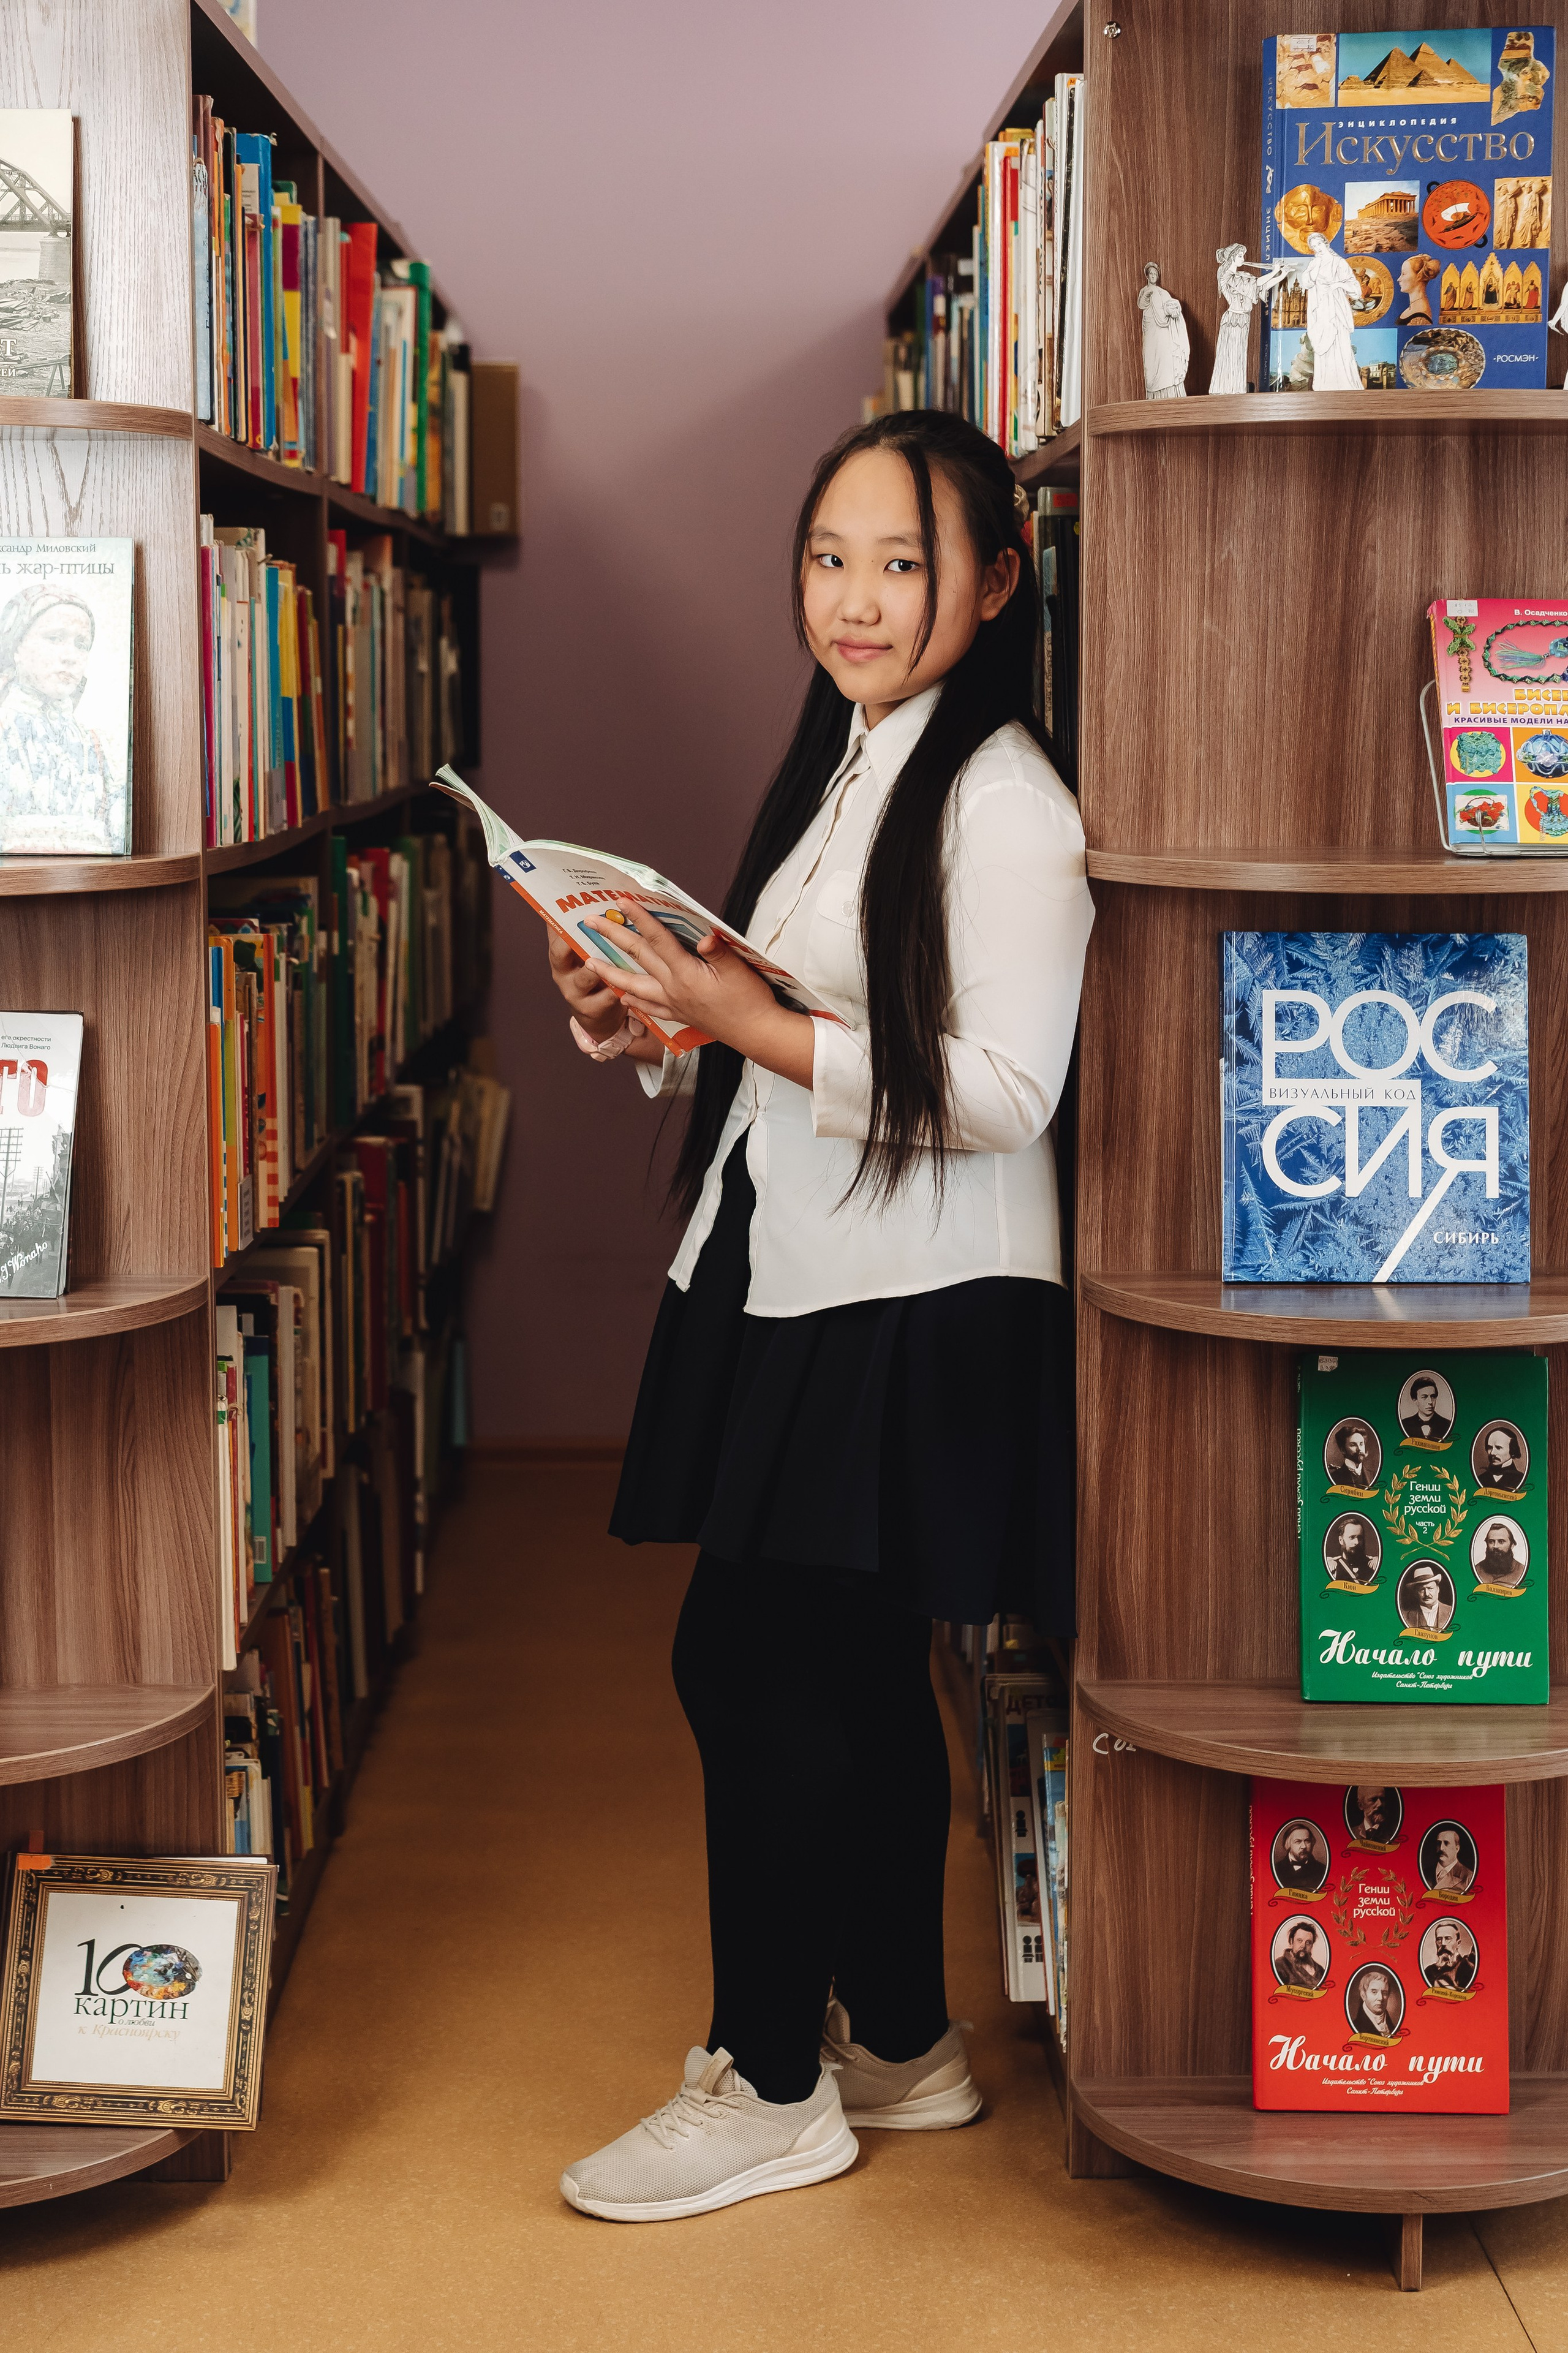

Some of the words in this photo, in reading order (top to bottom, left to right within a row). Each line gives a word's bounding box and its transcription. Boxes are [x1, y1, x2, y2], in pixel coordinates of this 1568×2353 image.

[1338, 117, 1457, 128] ЭНЦИКЛОПЕДИЯ
[1294, 122, 1535, 175] Искусство
[36, 543, 96, 553] Миловский
[16, 563, 115, 580] жар-птицы
[1447, 702, 1461, 716] И
[538, 910, 564, 934] МАТЕМАТИКА
[1262, 989, 1498, 1082] РОС
[1269, 1086, 1374, 1100] ВИЗУАЛЬНЫЙ
[1384, 1087, 1417, 1101] КОД
[1433, 1232, 1499, 1244] СИБИРЬ
[1411, 1438, 1441, 1450] Рахманинов
[1340, 1486, 1363, 1498] Скрябин
[1409, 1481, 1441, 1492] Гении
[1409, 1494, 1441, 1505] земли
[1404, 1503, 1446, 1516] русской
[1485, 1584, 1513, 1596] Балакирев
[1414, 1629, 1438, 1640] Глазунов
[1318, 1629, 1438, 1665] Начало
[1457, 1650, 1533, 1678] пути
[1371, 1671, 1416, 1680] Издательство
[1396, 1680, 1452, 1690] Санкт-Петербург
[1288, 1889, 1308, 1900] Глинка
[1359, 1883, 1390, 1894] Гении
[1358, 1897, 1390, 1907] земли
[1353, 1906, 1396, 1919] русской
[74, 1997, 189, 2025] картин
[92, 2023, 181, 2042] Красноярску
[1268, 2034, 1388, 2071] Начало
[1408, 2055, 1485, 2083] пути
[1322, 2077, 1366, 2086] Издательство
[1346, 2087, 1403, 2097] Санкт-Петербург
